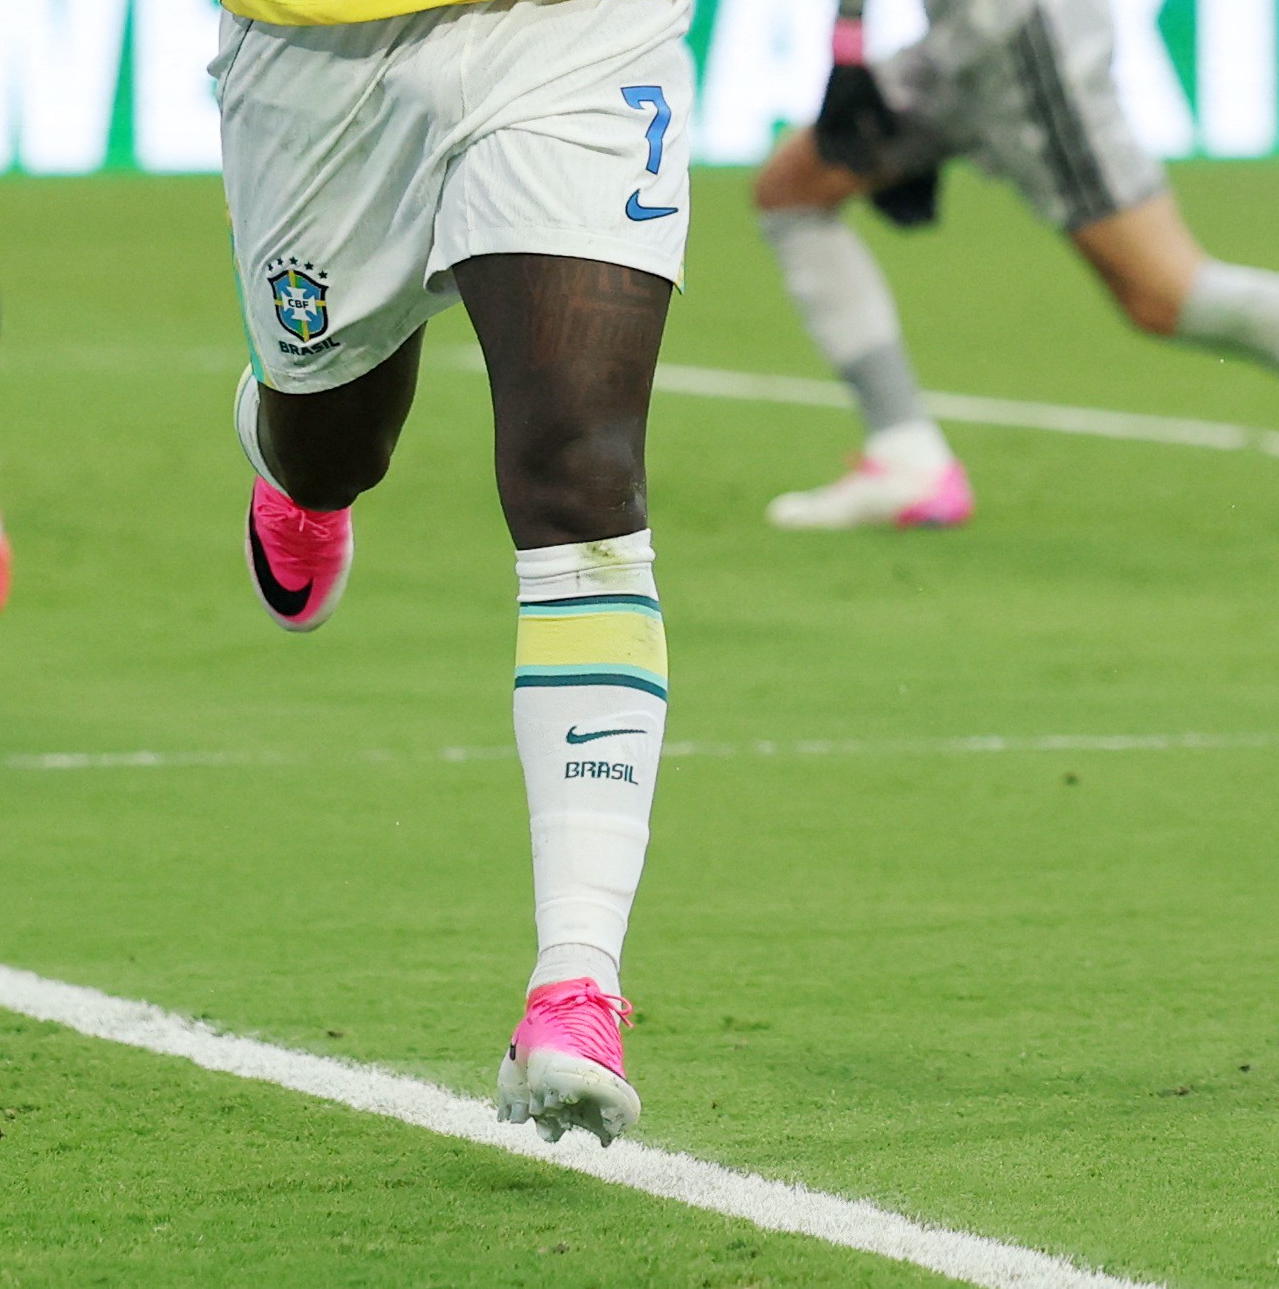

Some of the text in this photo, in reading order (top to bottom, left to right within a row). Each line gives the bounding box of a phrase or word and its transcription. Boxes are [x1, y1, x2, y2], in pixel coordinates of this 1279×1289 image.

[620, 84, 672, 175] 7
[287, 298, 309, 309] CBF
[278, 336, 341, 356] BRASIL
[564, 760, 639, 785] BRASIL
